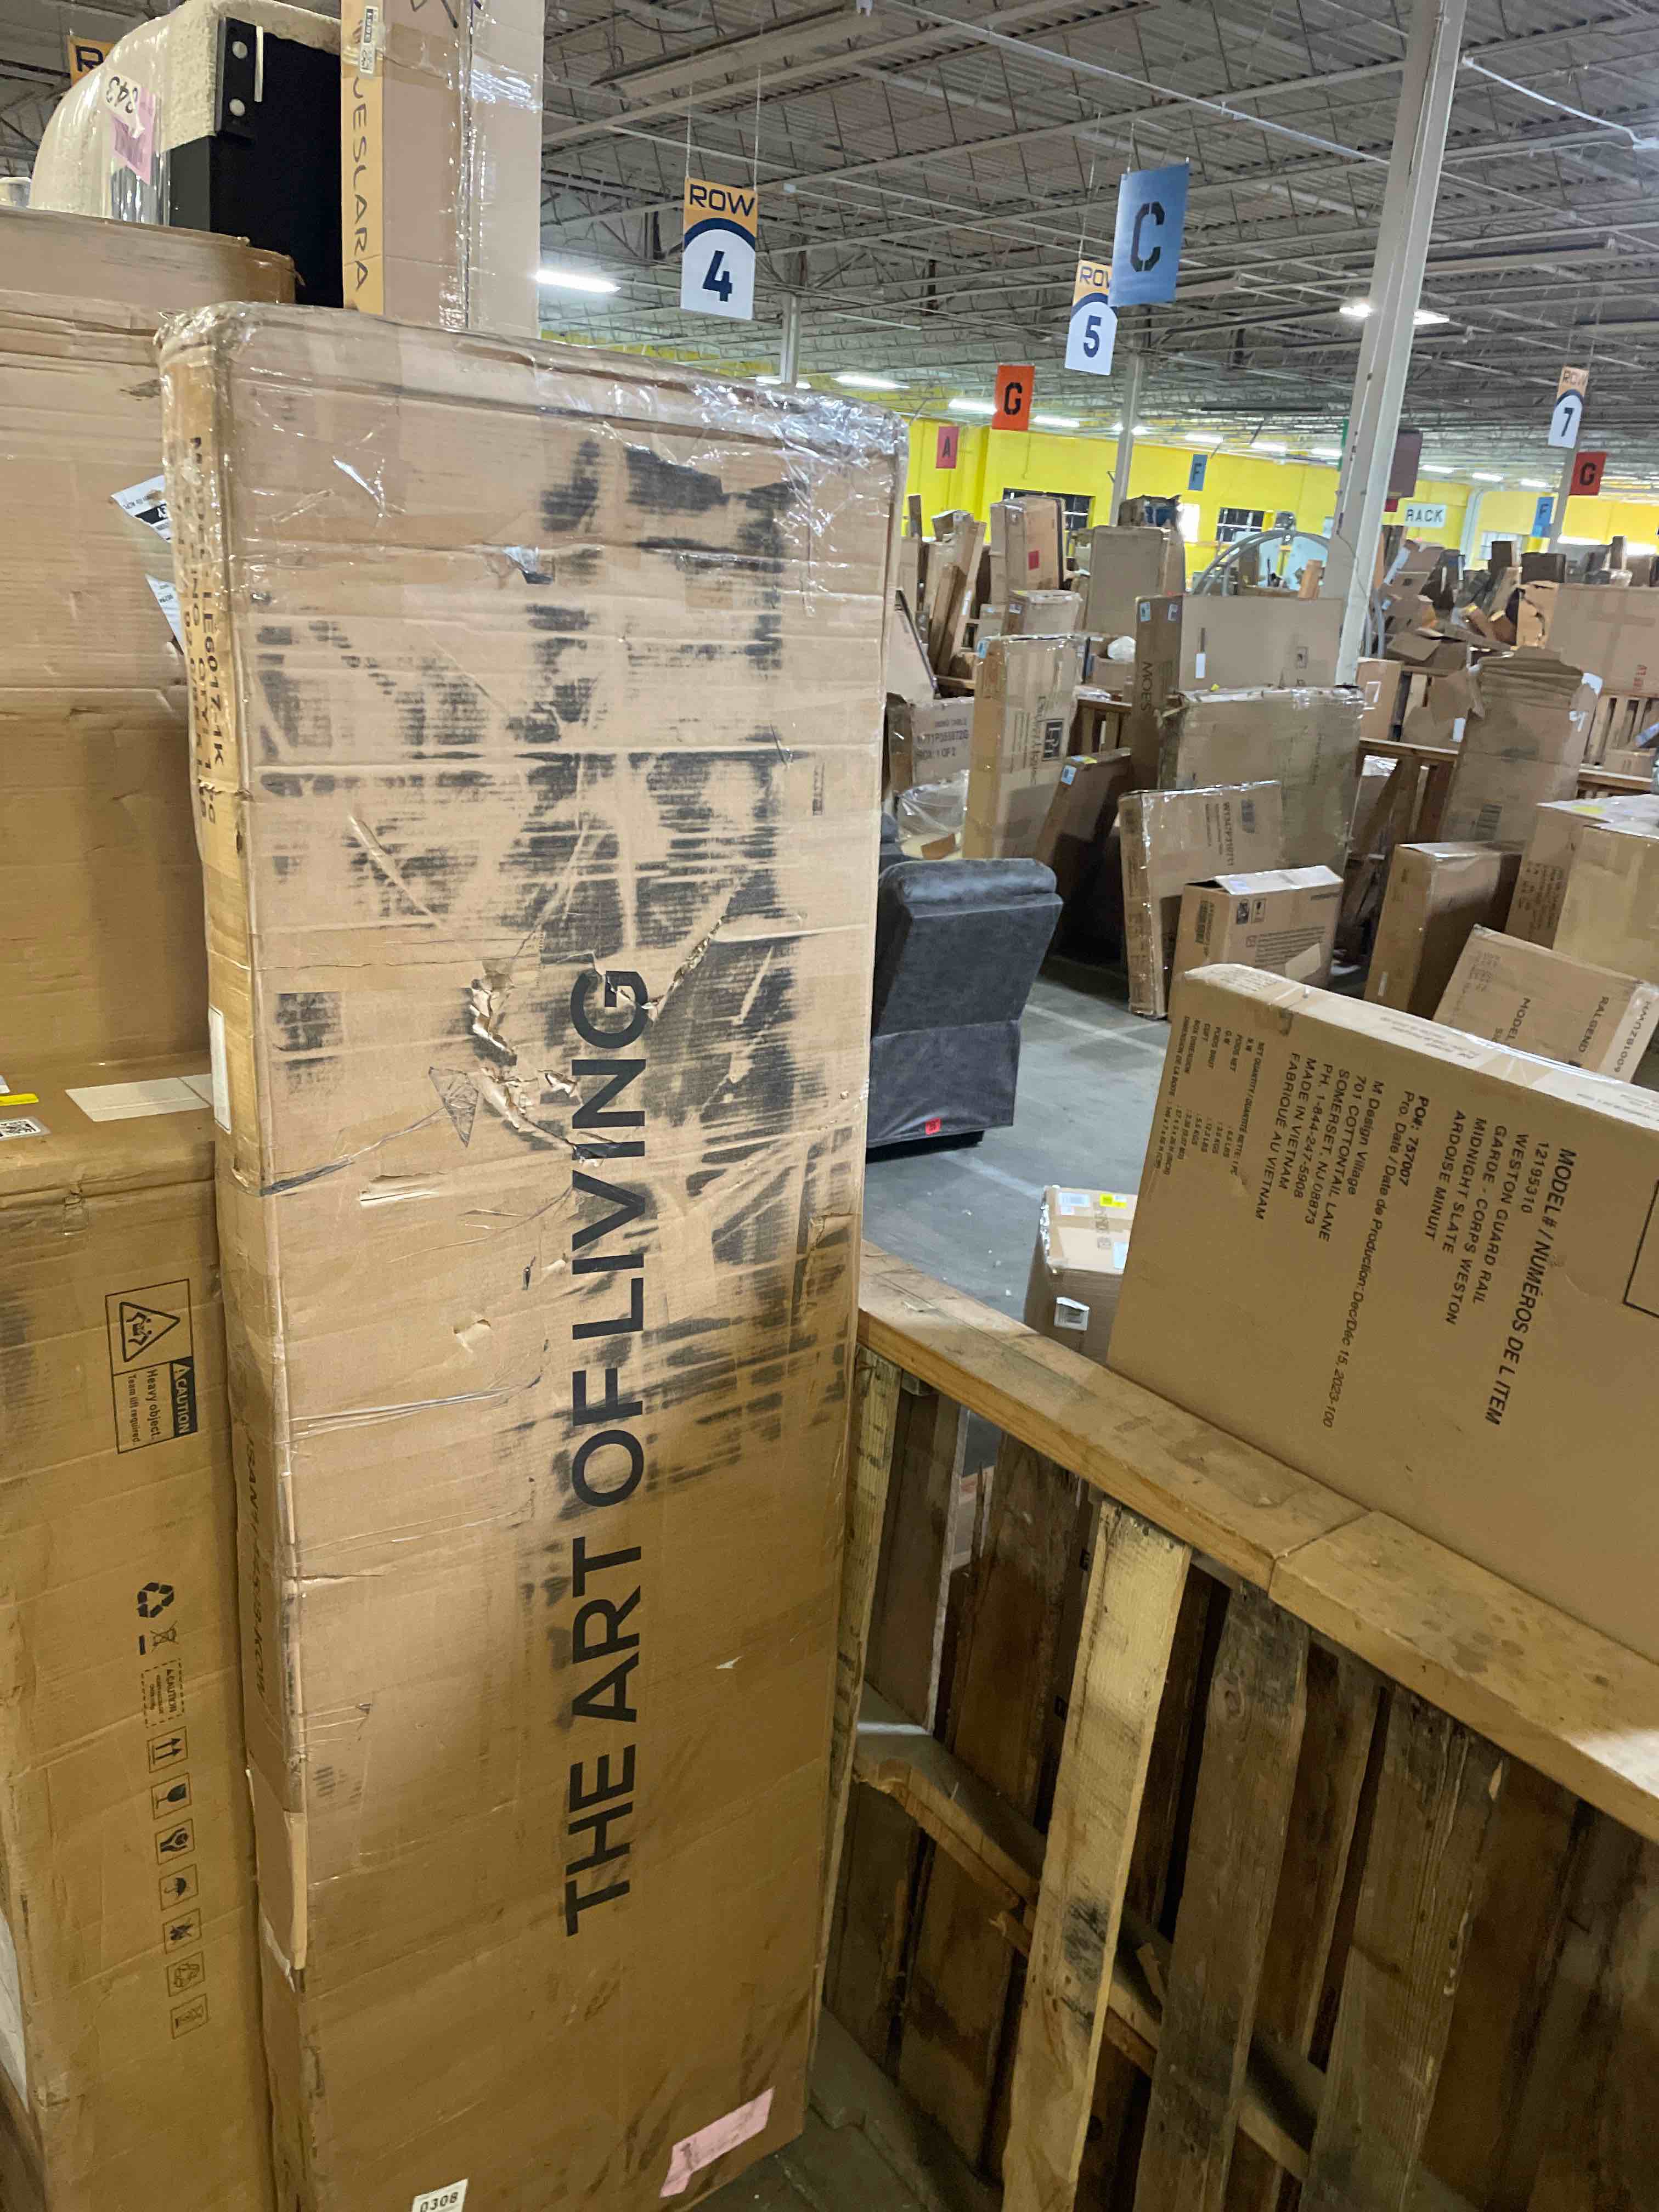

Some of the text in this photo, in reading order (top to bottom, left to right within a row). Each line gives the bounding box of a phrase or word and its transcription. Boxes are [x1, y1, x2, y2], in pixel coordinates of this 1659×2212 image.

[689, 184, 755, 217] ROW
[1130, 201, 1166, 273] C
[703, 250, 733, 302] 4
[1080, 266, 1109, 289] RO
[1083, 315, 1102, 358] 5
[1003, 382, 1023, 415] G
[1560, 407, 1575, 437] 7
[943, 436, 951, 458] A
[1190, 464, 1203, 482] F
[1580, 464, 1597, 486] G
[1405, 509, 1444, 523] RACK
[1538, 503, 1548, 519] F
[1141, 661, 1153, 711] MOES
[1255, 1052, 1301, 1220] FABRIQUÉ AU VIETNAM
[1278, 1057, 1317, 1190] MADE IN VIETNAM
[1347, 1080, 1385, 1195] M Design Village
[1390, 1122, 1407, 1154] Date
[1315, 1160, 1328, 1180] NJ
[1318, 1074, 1367, 1243] 701 COTTONTAIL LANE
[1399, 1137, 1419, 1187] 757007
[1424, 1109, 1466, 1242] ARDOISE MINUIT
[1482, 1125, 1508, 1184] GARDE
[1379, 1164, 1397, 1197] Date
[1442, 1116, 1487, 1254] MIDNIGHT SLATE
[1521, 1142, 1550, 1214] 12195310
[1305, 1182, 1323, 1225] 08873
[1374, 1198, 1387, 1216] de
[1464, 1198, 1488, 1253] CORPS
[1472, 1133, 1530, 1304] WESTON GUARD RAIL
[1445, 1257, 1472, 1325] WESTON
[1512, 1240, 1551, 1334] NUMÉROS
[1503, 1336, 1524, 1364] DE
[127, 1373, 137, 1396] Team
[145, 1369, 159, 1402] Heavy
[175, 1378, 190, 1434] CAUTION
[1485, 1380, 1511, 1426] ITEM
[565, 969, 652, 1938] THE ART OF LIVING
[420, 2192, 459, 2212] 0308
